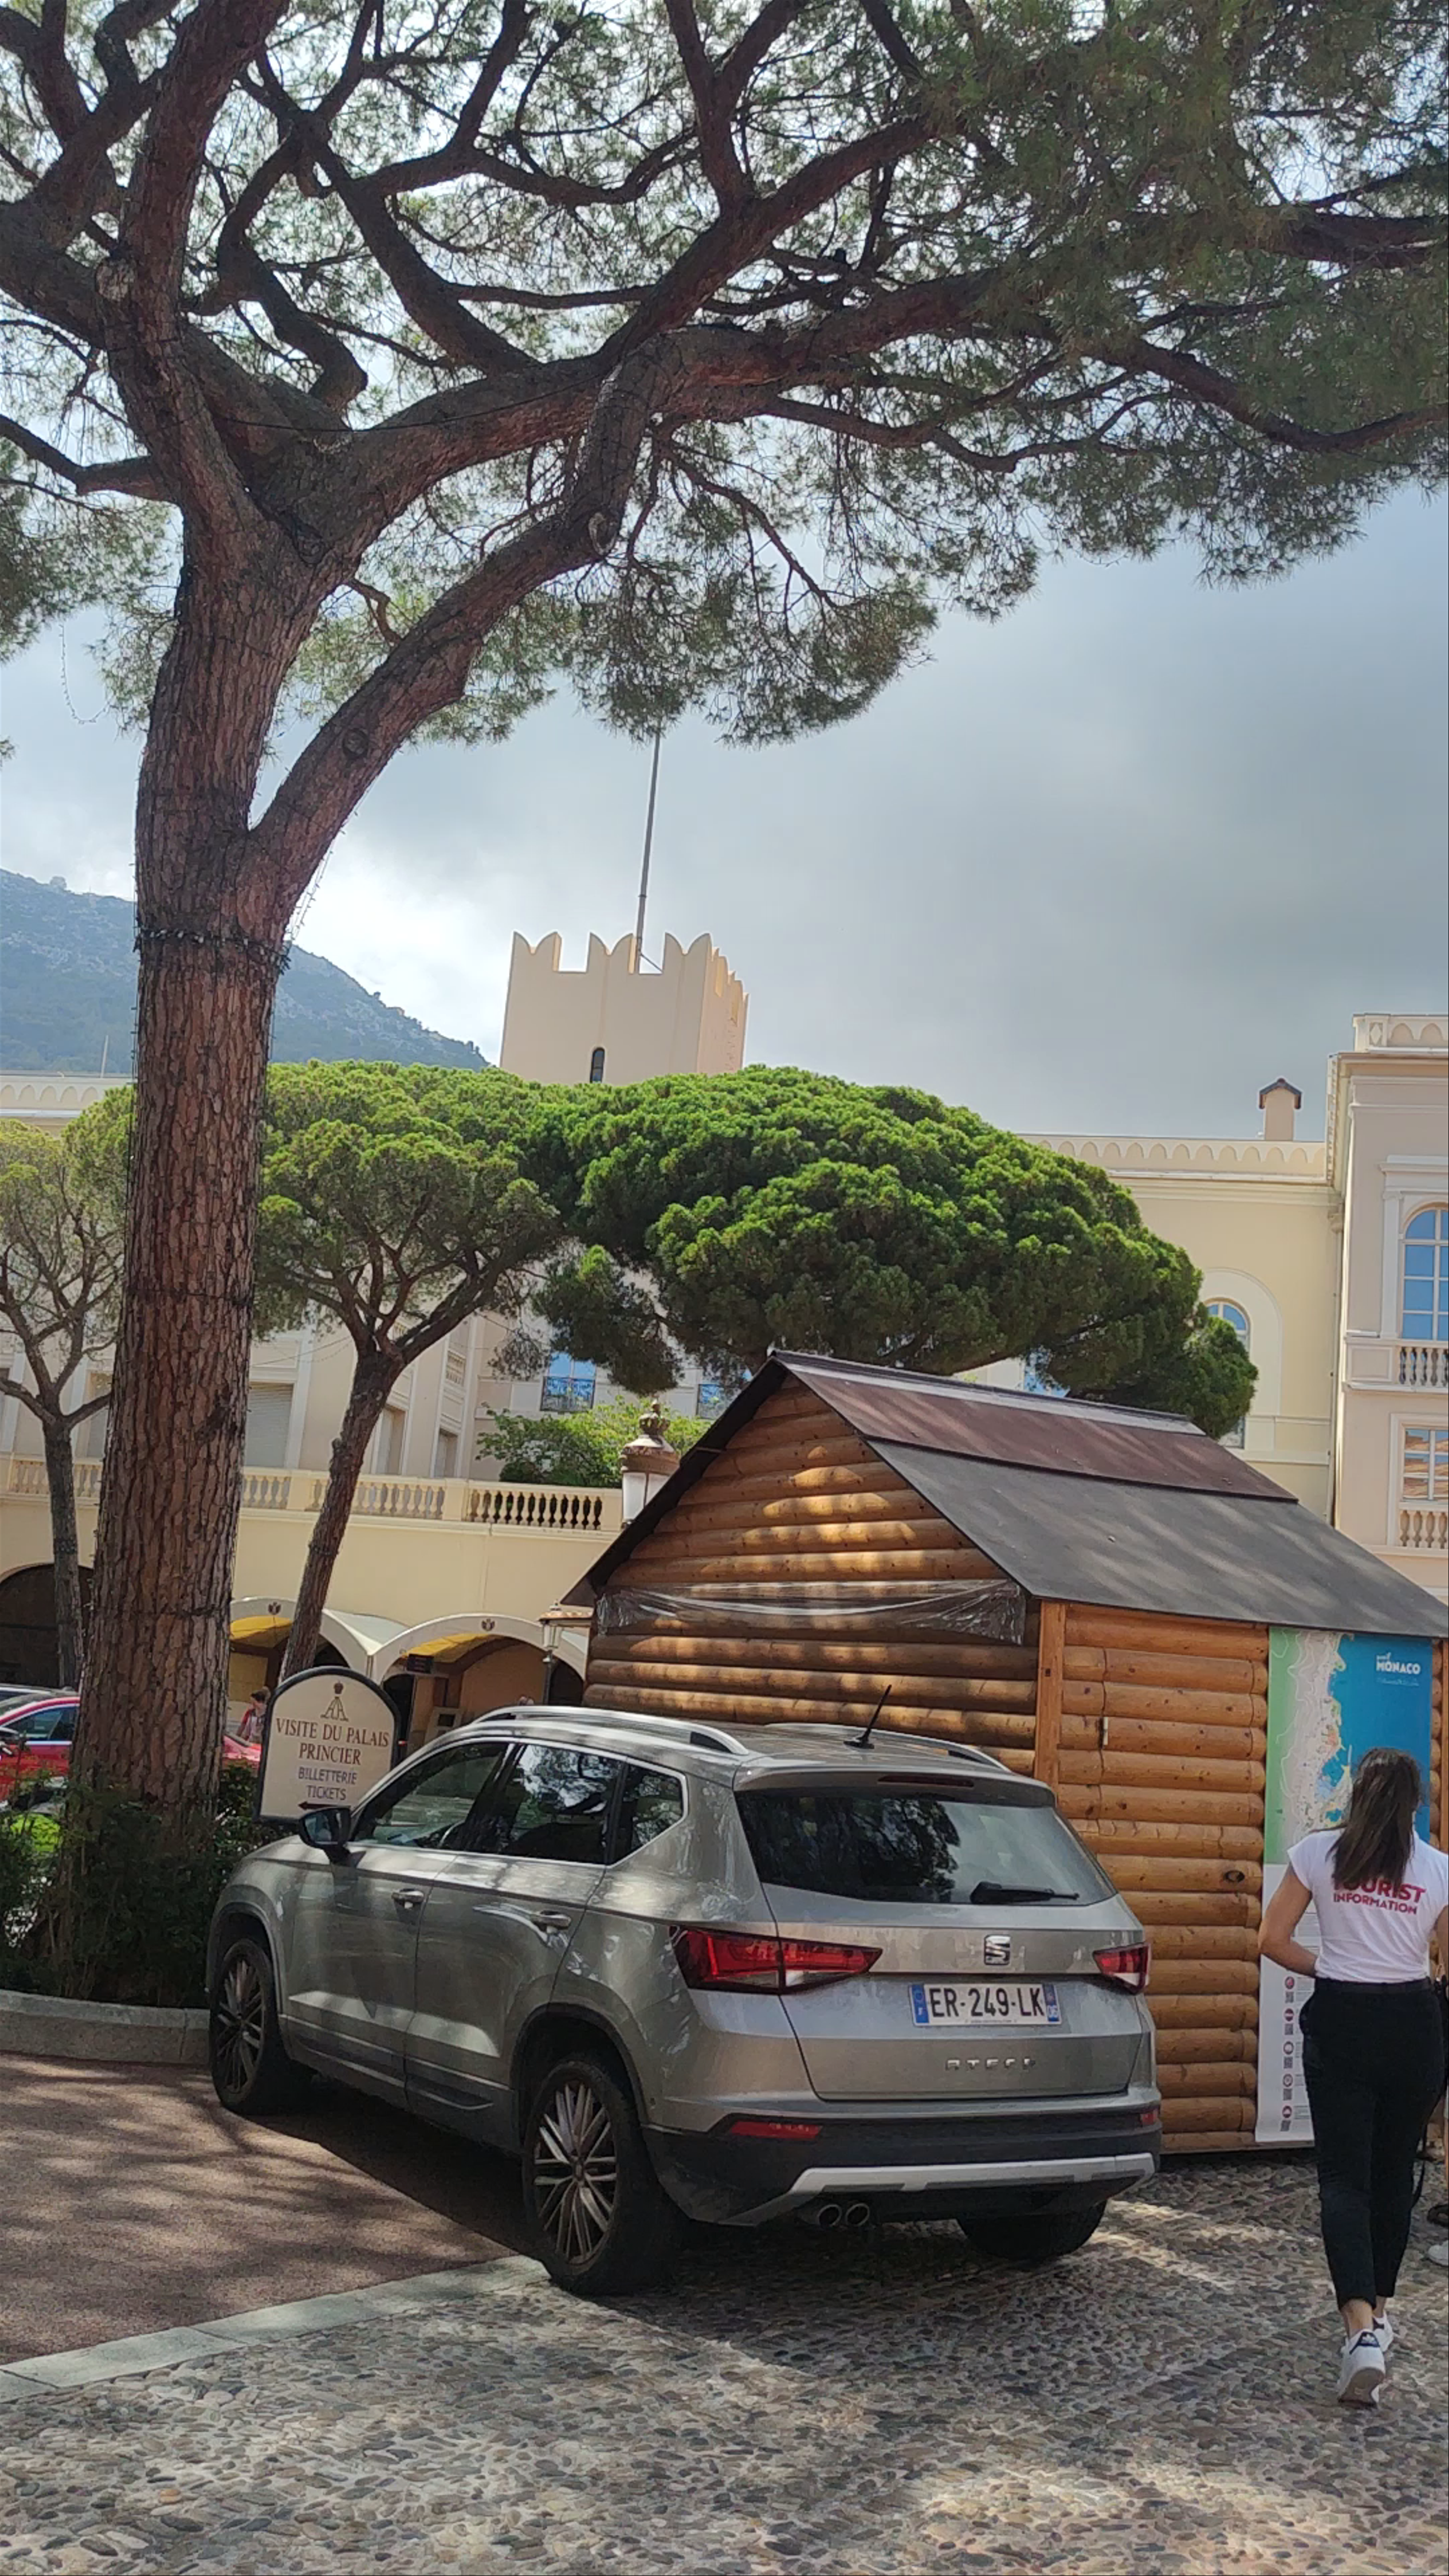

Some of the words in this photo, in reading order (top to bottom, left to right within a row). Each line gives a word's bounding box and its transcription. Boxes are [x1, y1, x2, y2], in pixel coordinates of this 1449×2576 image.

[1376, 1661, 1421, 1674] MONACO
[276, 1718, 318, 1739] VISITE
[323, 1724, 342, 1740] DU
[346, 1727, 389, 1747] PALAIS
[298, 1742, 361, 1765] PRINCIER
[298, 1767, 357, 1784] BILLETTERIE
[307, 1785, 346, 1800] TICKETS
[1334, 1877, 1426, 1903] URIST
[1333, 1893, 1417, 1915] INFORMATION
